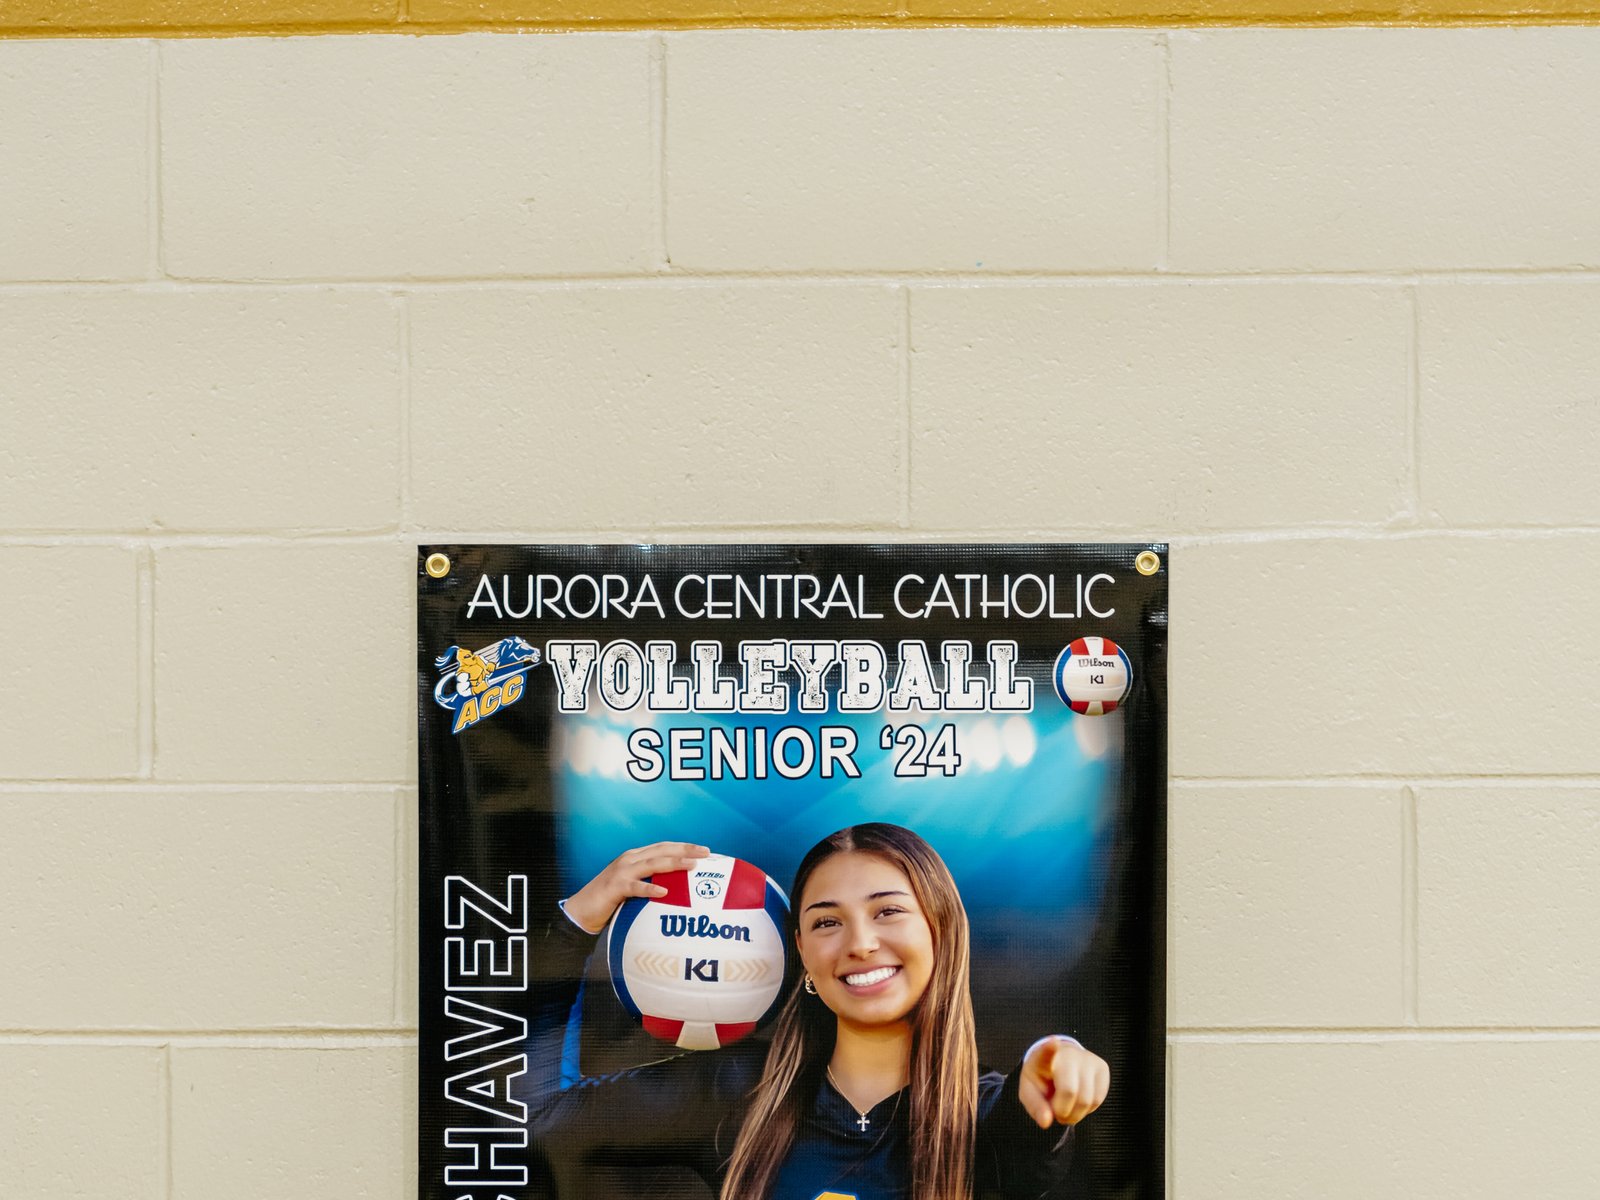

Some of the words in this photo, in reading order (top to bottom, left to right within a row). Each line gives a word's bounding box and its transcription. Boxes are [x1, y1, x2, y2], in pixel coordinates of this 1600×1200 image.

[466, 573, 666, 619] AURORA
[674, 573, 884, 619] CENTRAL
[893, 573, 1117, 619] CATHOLIC
[546, 638, 1035, 715] VOLLEYBALL
[452, 674, 525, 734] ACC
[626, 726, 862, 783] SENIOR
[659, 914, 751, 942] Wilson
[684, 957, 719, 982] K1
